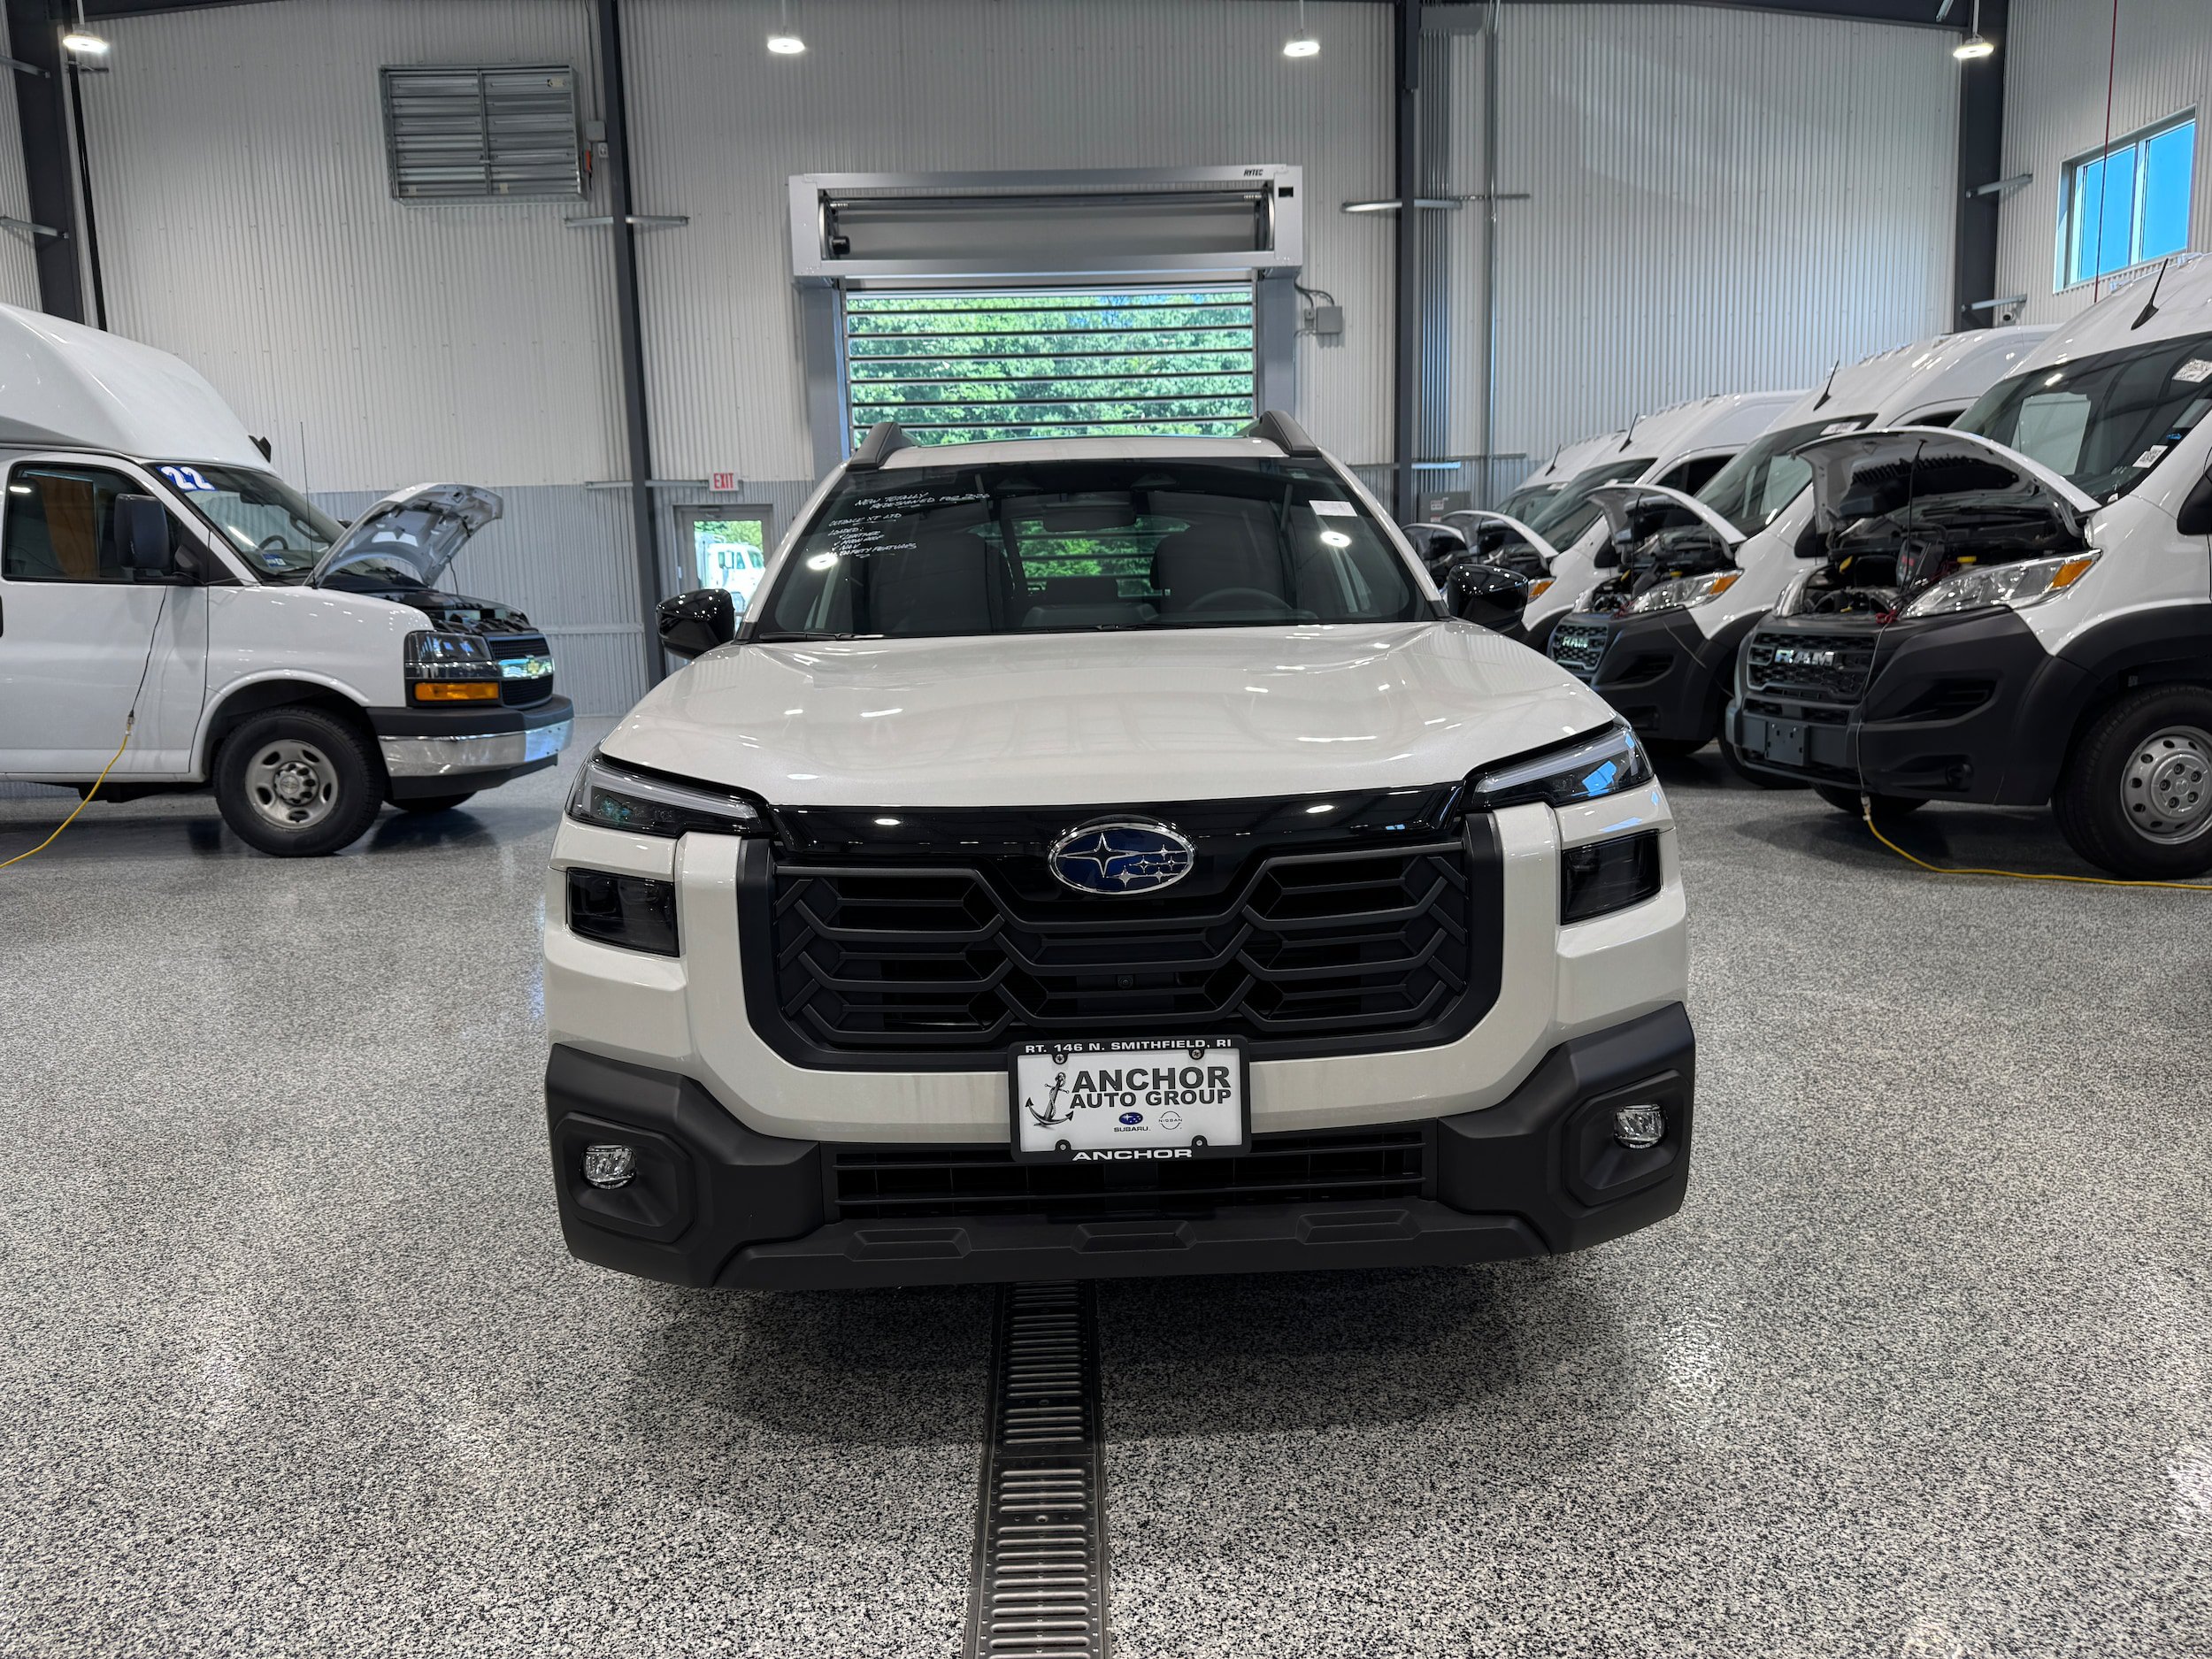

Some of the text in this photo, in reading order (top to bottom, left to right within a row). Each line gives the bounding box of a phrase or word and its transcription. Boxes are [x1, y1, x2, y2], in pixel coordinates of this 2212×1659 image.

[161, 465, 216, 490] 22
[713, 472, 733, 488] EXIT
[1562, 636, 1589, 648] RAM
[1774, 649, 1835, 665] RAM
[1025, 1039, 1232, 1053] RT. 146 N. SMITHFIELD, RI
[1071, 1065, 1232, 1094] ANCHOR
[1069, 1089, 1232, 1110] AUTO GROUP
[1072, 1148, 1193, 1161] ANCHOR
